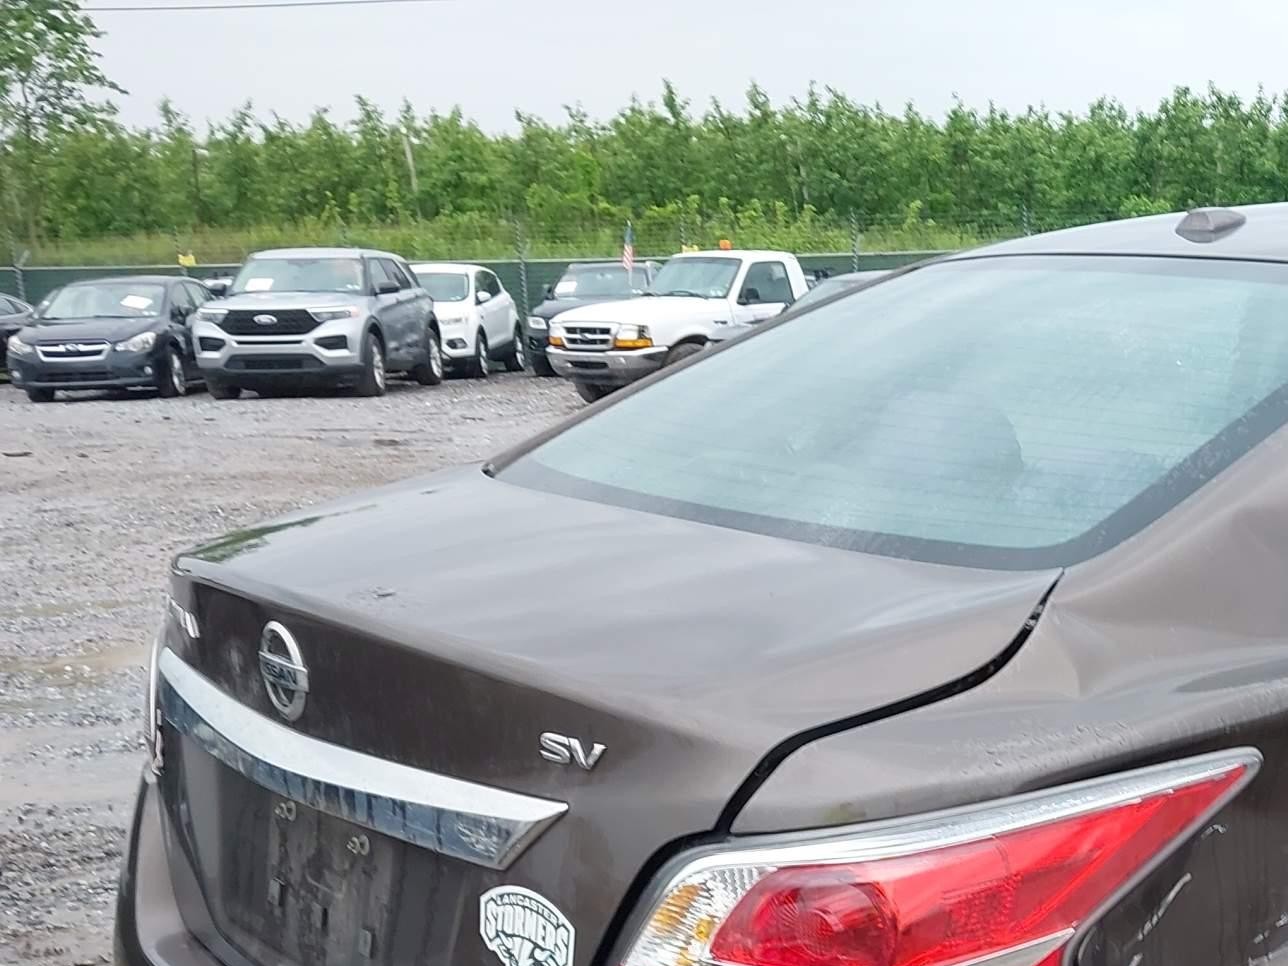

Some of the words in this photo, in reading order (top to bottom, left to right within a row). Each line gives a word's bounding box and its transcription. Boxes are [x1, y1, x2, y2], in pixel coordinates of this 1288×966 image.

[261, 660, 299, 686] SSAN
[539, 731, 608, 770] SV
[496, 893, 560, 927] LANCASTER
